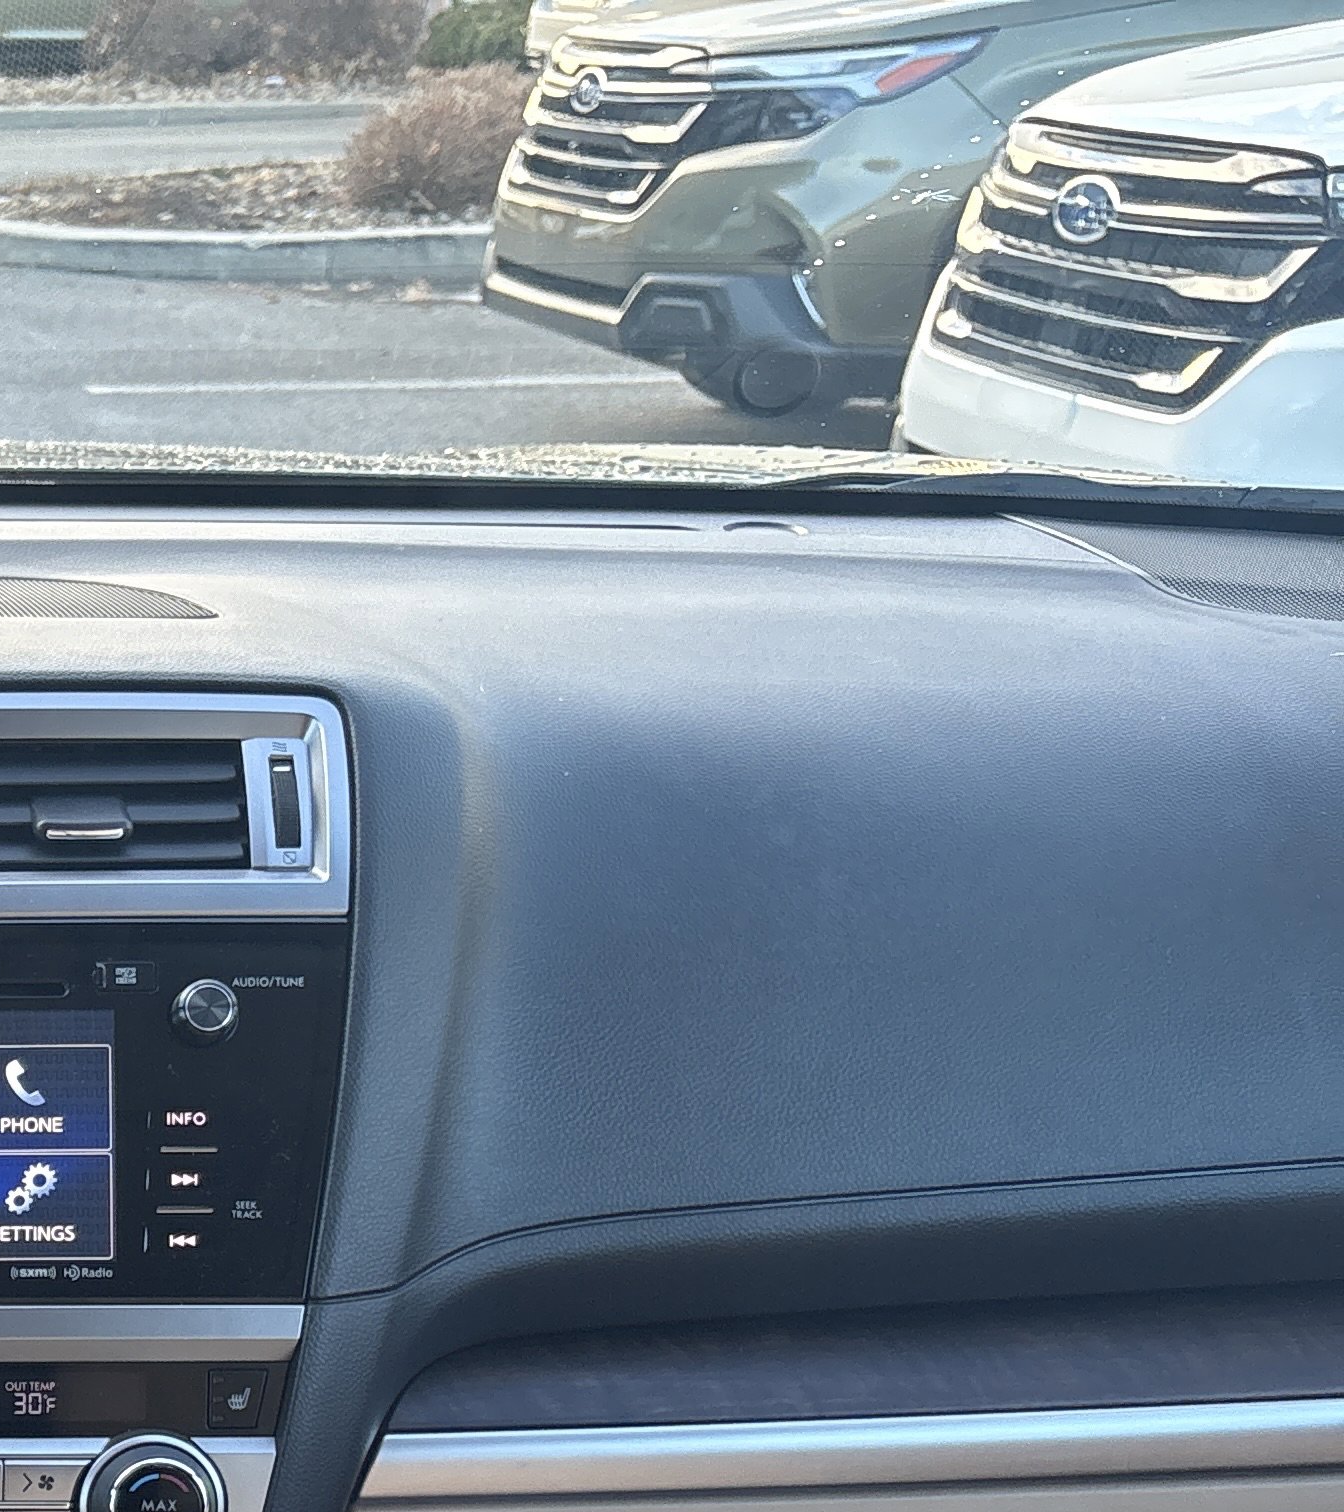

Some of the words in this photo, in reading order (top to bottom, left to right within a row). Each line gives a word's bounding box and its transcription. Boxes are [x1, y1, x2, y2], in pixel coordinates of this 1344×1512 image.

[231, 976, 305, 988] AUDIO/TUNE
[0, 1116, 64, 1133] PHONE
[165, 1111, 207, 1126] INFO
[235, 1201, 257, 1210] SEEK
[232, 1209, 262, 1220] TRACK
[81, 1267, 114, 1279] Radio
[5, 1381, 28, 1392] OUT
[28, 1381, 56, 1391] TEMP
[140, 1500, 178, 1512] MAX
